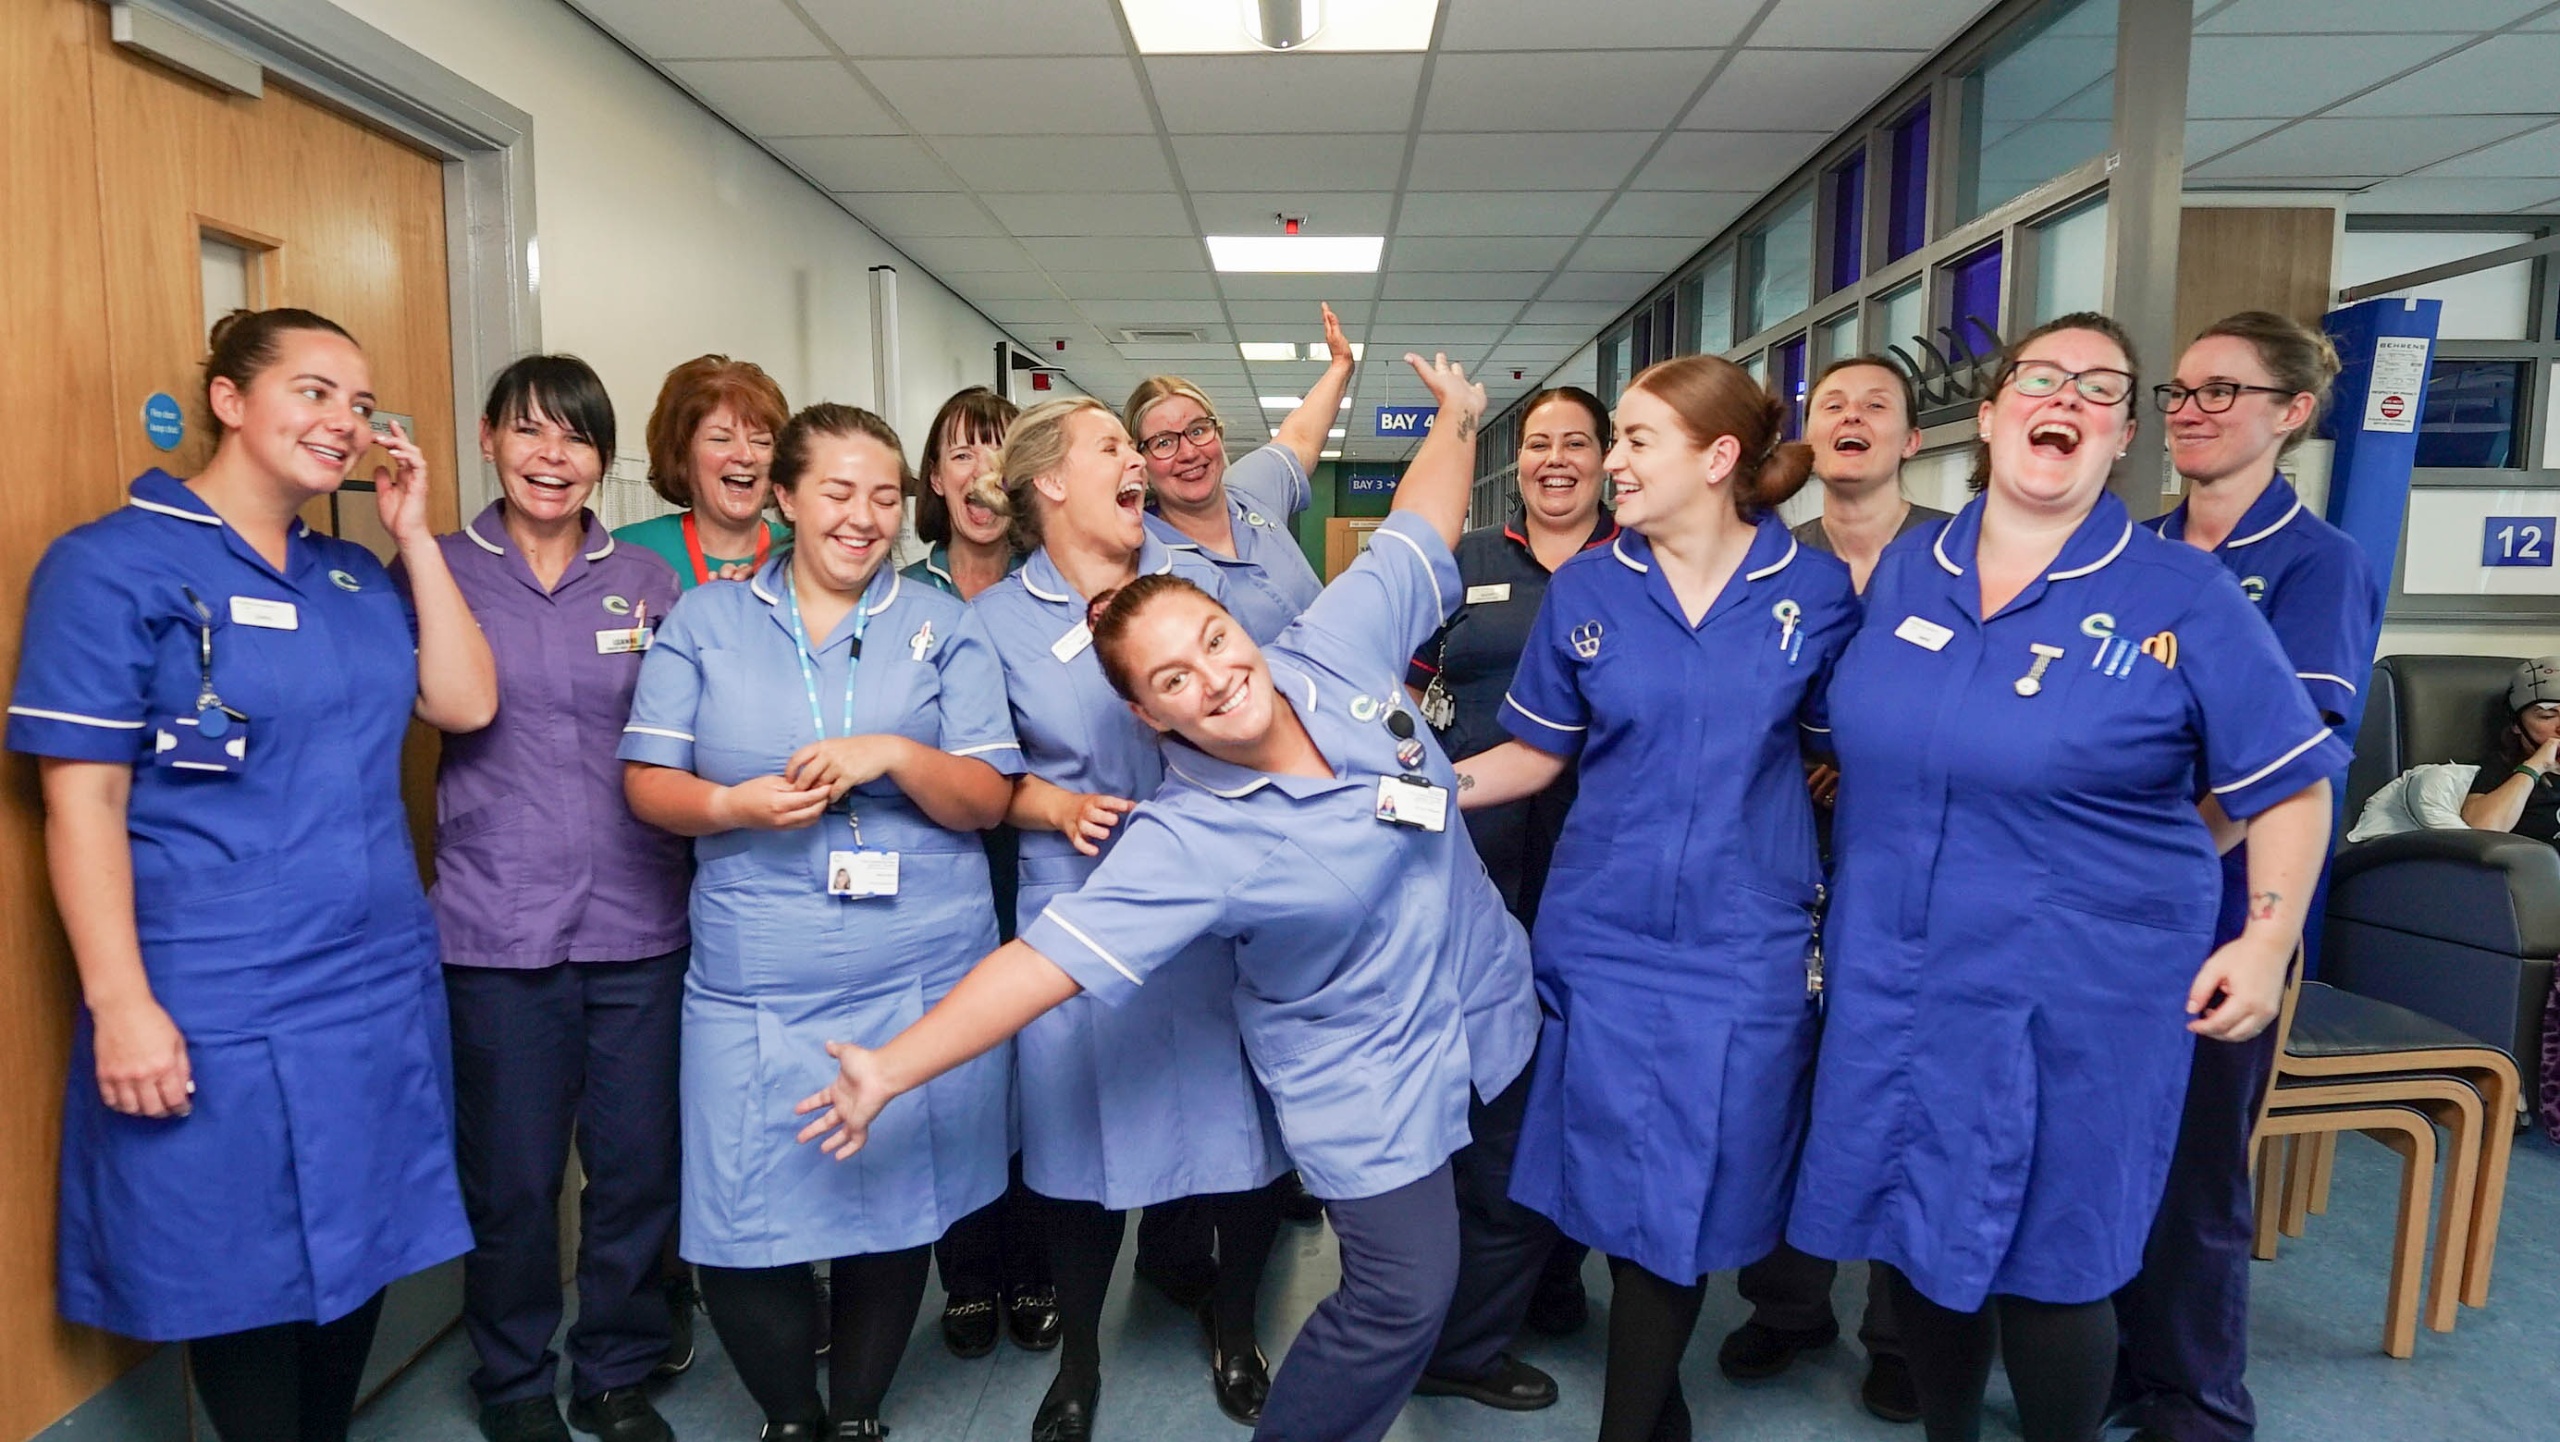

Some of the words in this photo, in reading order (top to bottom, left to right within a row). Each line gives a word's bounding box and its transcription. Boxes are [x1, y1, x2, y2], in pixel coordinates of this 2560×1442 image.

[2380, 342, 2426, 350] BEHRENS
[1381, 413, 1418, 430] BAY
[1424, 413, 1435, 429] 4
[1353, 480, 1373, 490] BAY
[1376, 480, 1383, 490] 3
[2497, 525, 2542, 558] 12
